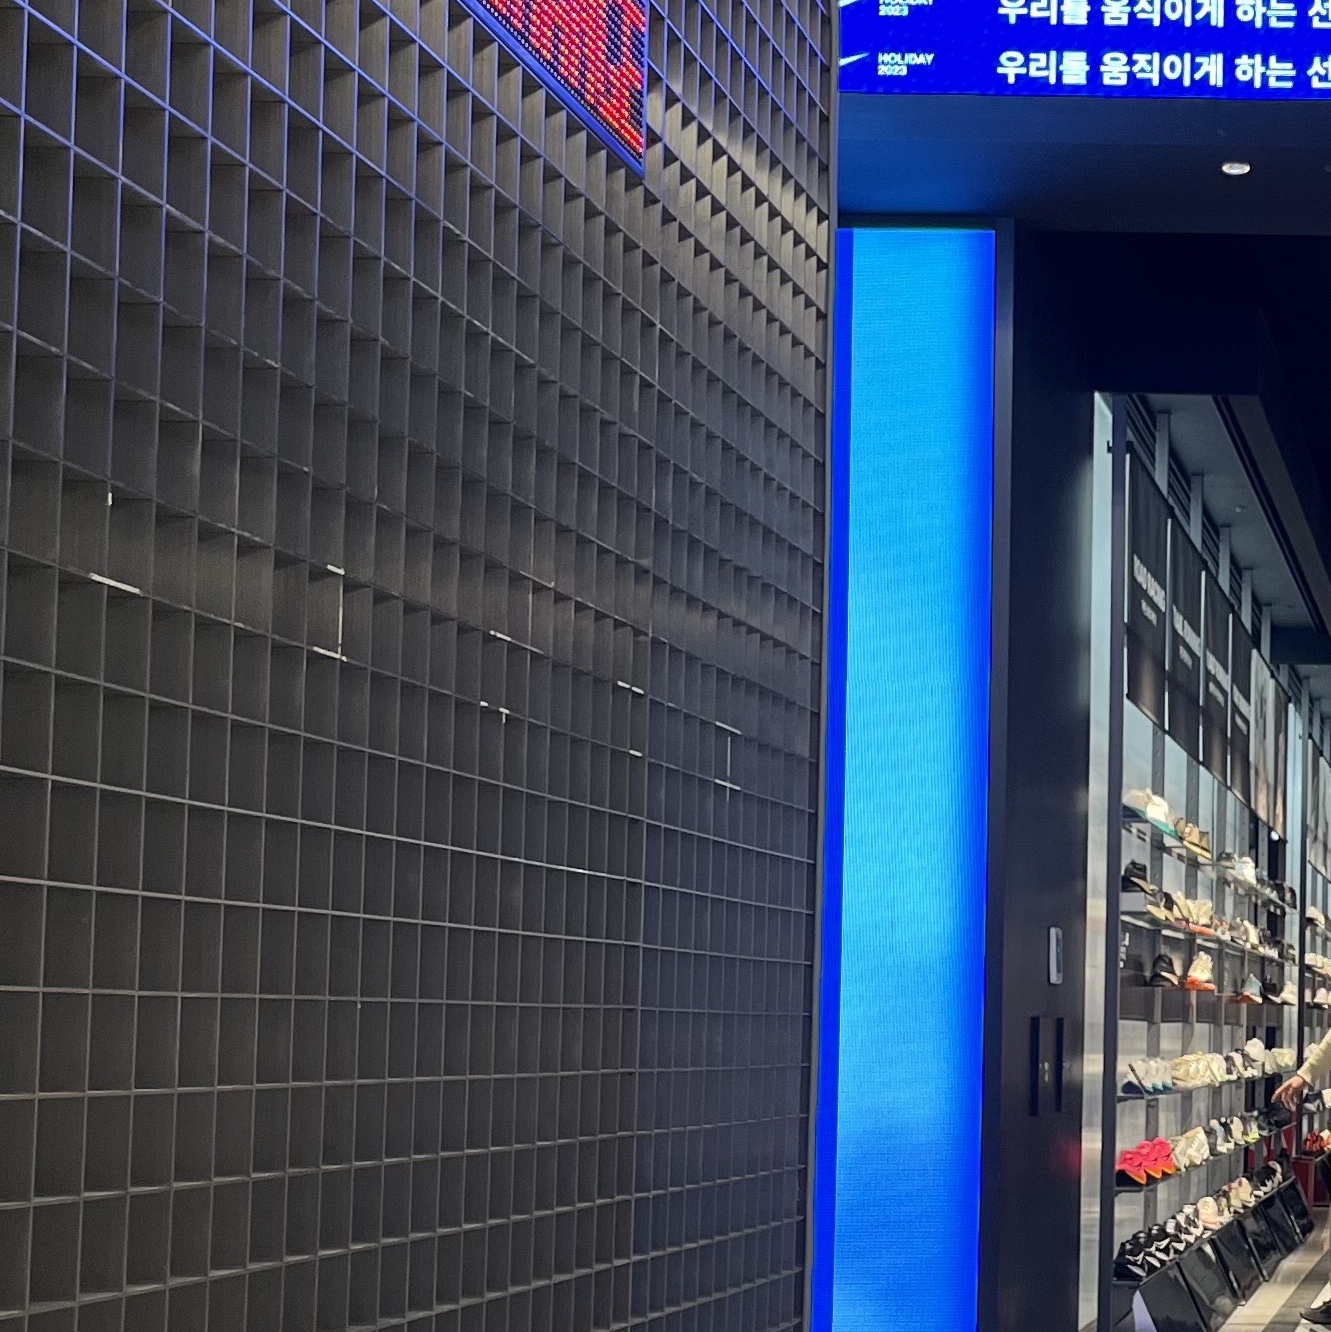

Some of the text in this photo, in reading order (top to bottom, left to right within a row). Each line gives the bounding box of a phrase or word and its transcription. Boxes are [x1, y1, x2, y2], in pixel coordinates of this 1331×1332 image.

[998, 0, 1091, 25] 우리를
[1101, 0, 1224, 27] 움직이게
[1235, 0, 1297, 28] 하는
[878, 52, 934, 65] HOLIDAY
[997, 50, 1090, 85] 우리를
[1100, 52, 1223, 87] 움직이게
[1235, 54, 1296, 88] 하는
